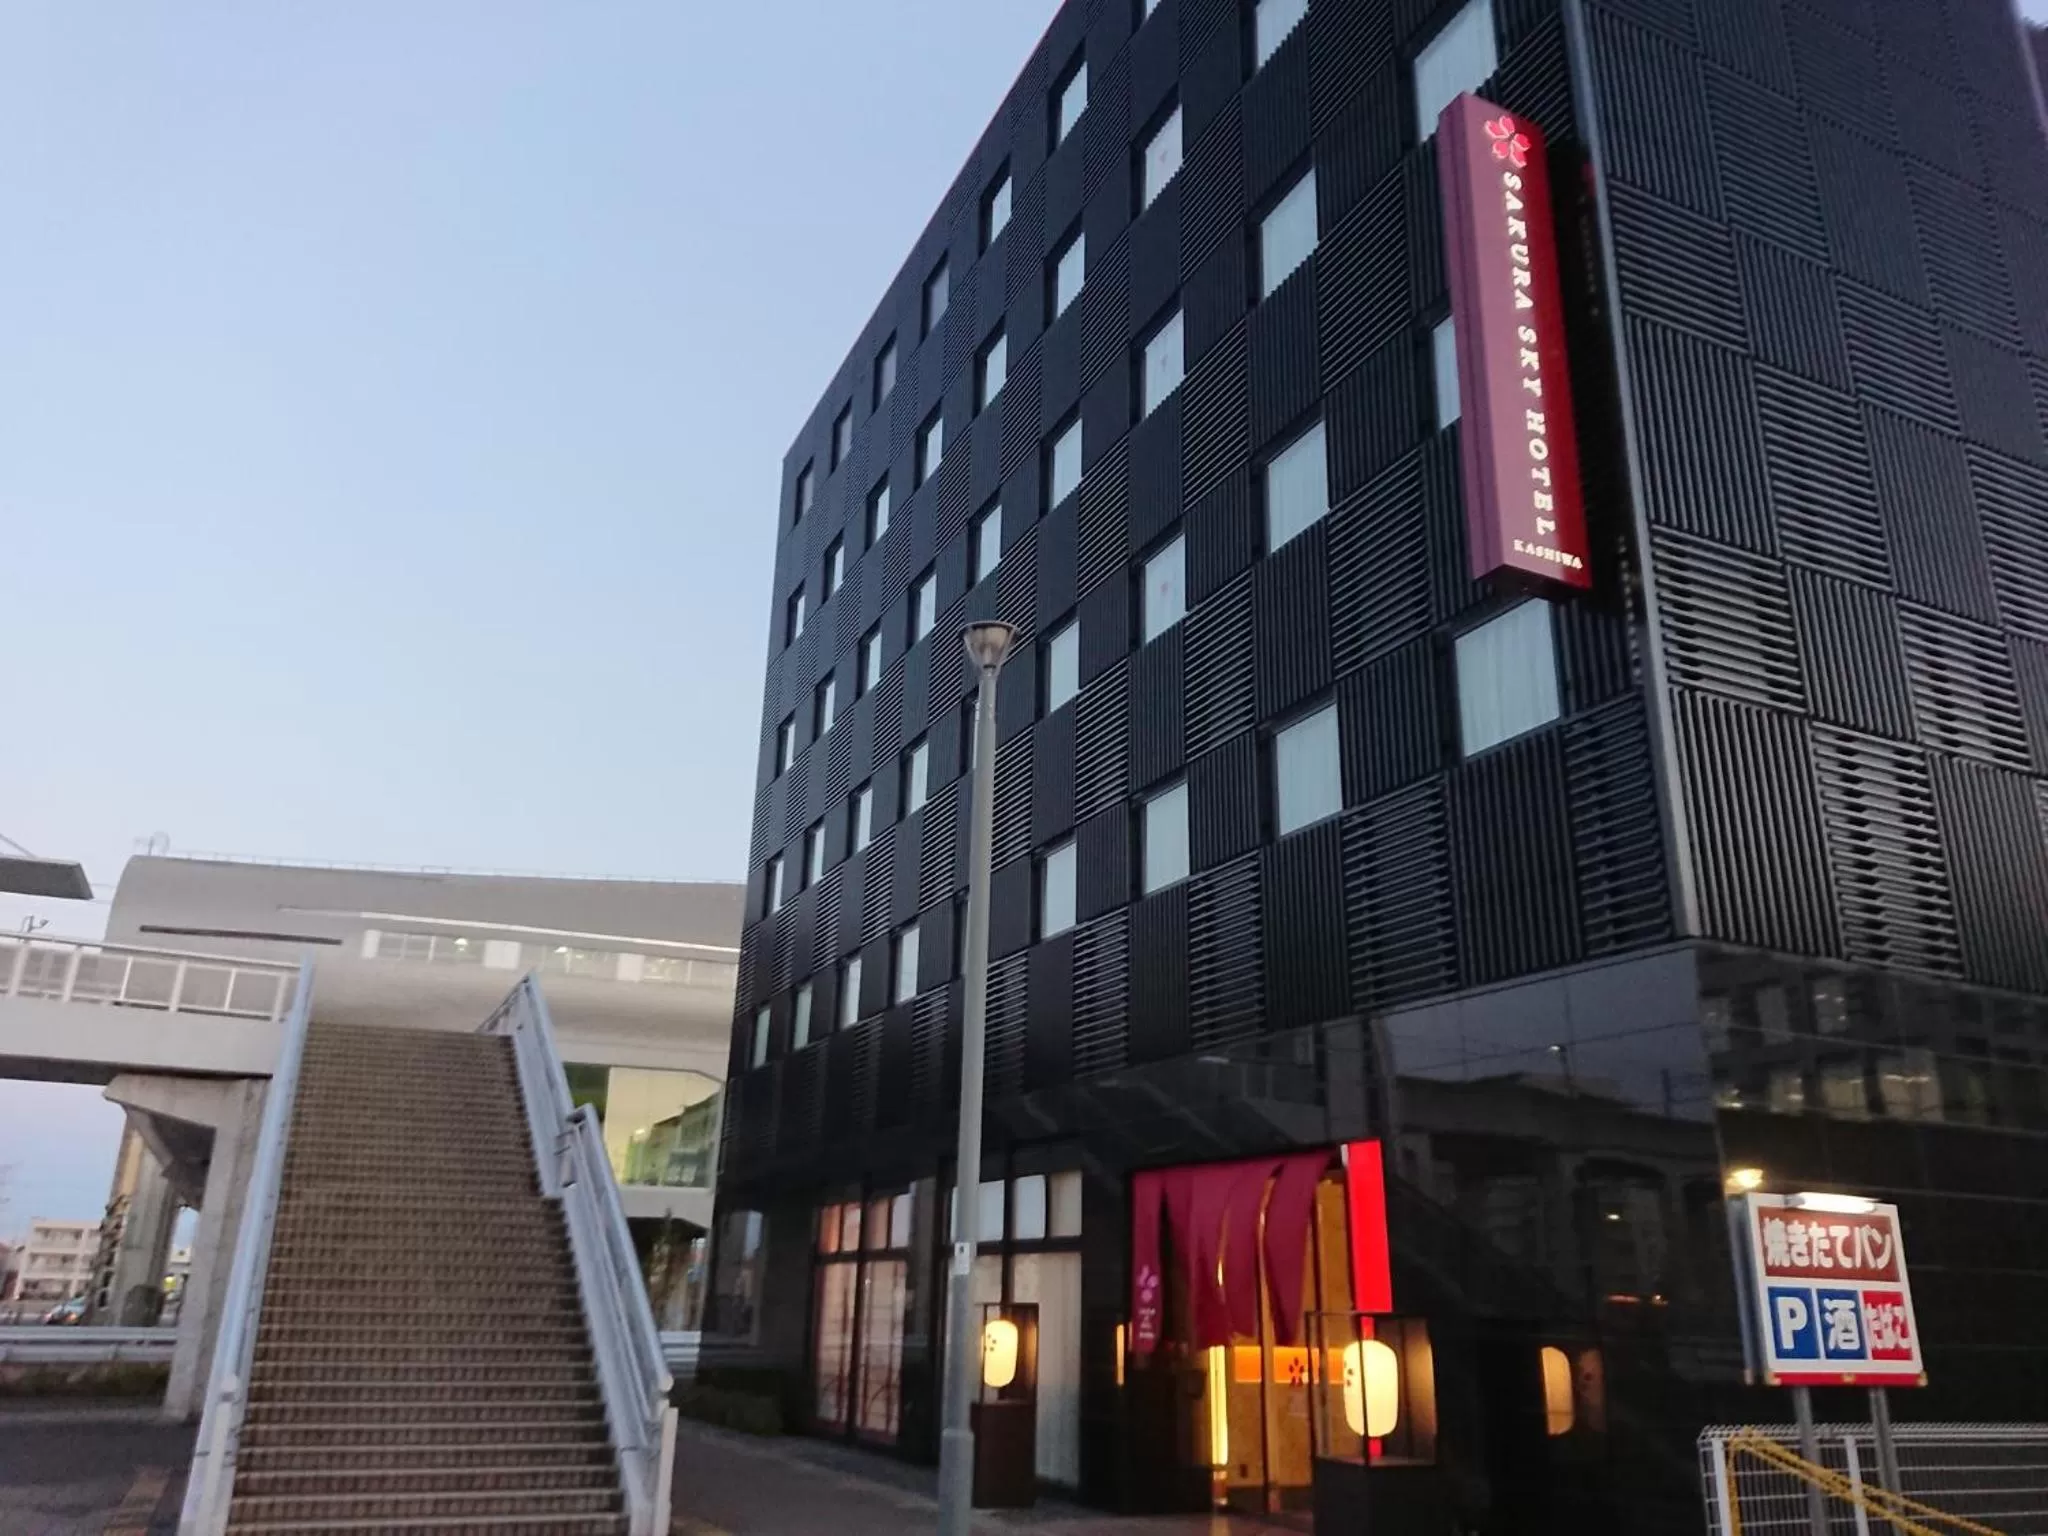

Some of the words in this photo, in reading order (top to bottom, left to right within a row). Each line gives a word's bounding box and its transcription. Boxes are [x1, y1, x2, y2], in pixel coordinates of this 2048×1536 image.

[1503, 171, 1534, 309] SAKURA
[1517, 325, 1543, 398] SKY
[1525, 408, 1556, 536] HOTEL
[1513, 538, 1583, 570] KASHIWA
[1776, 1296, 1809, 1350] P
[1823, 1297, 1861, 1351] 酒
[1864, 1302, 1912, 1350] たばこ
